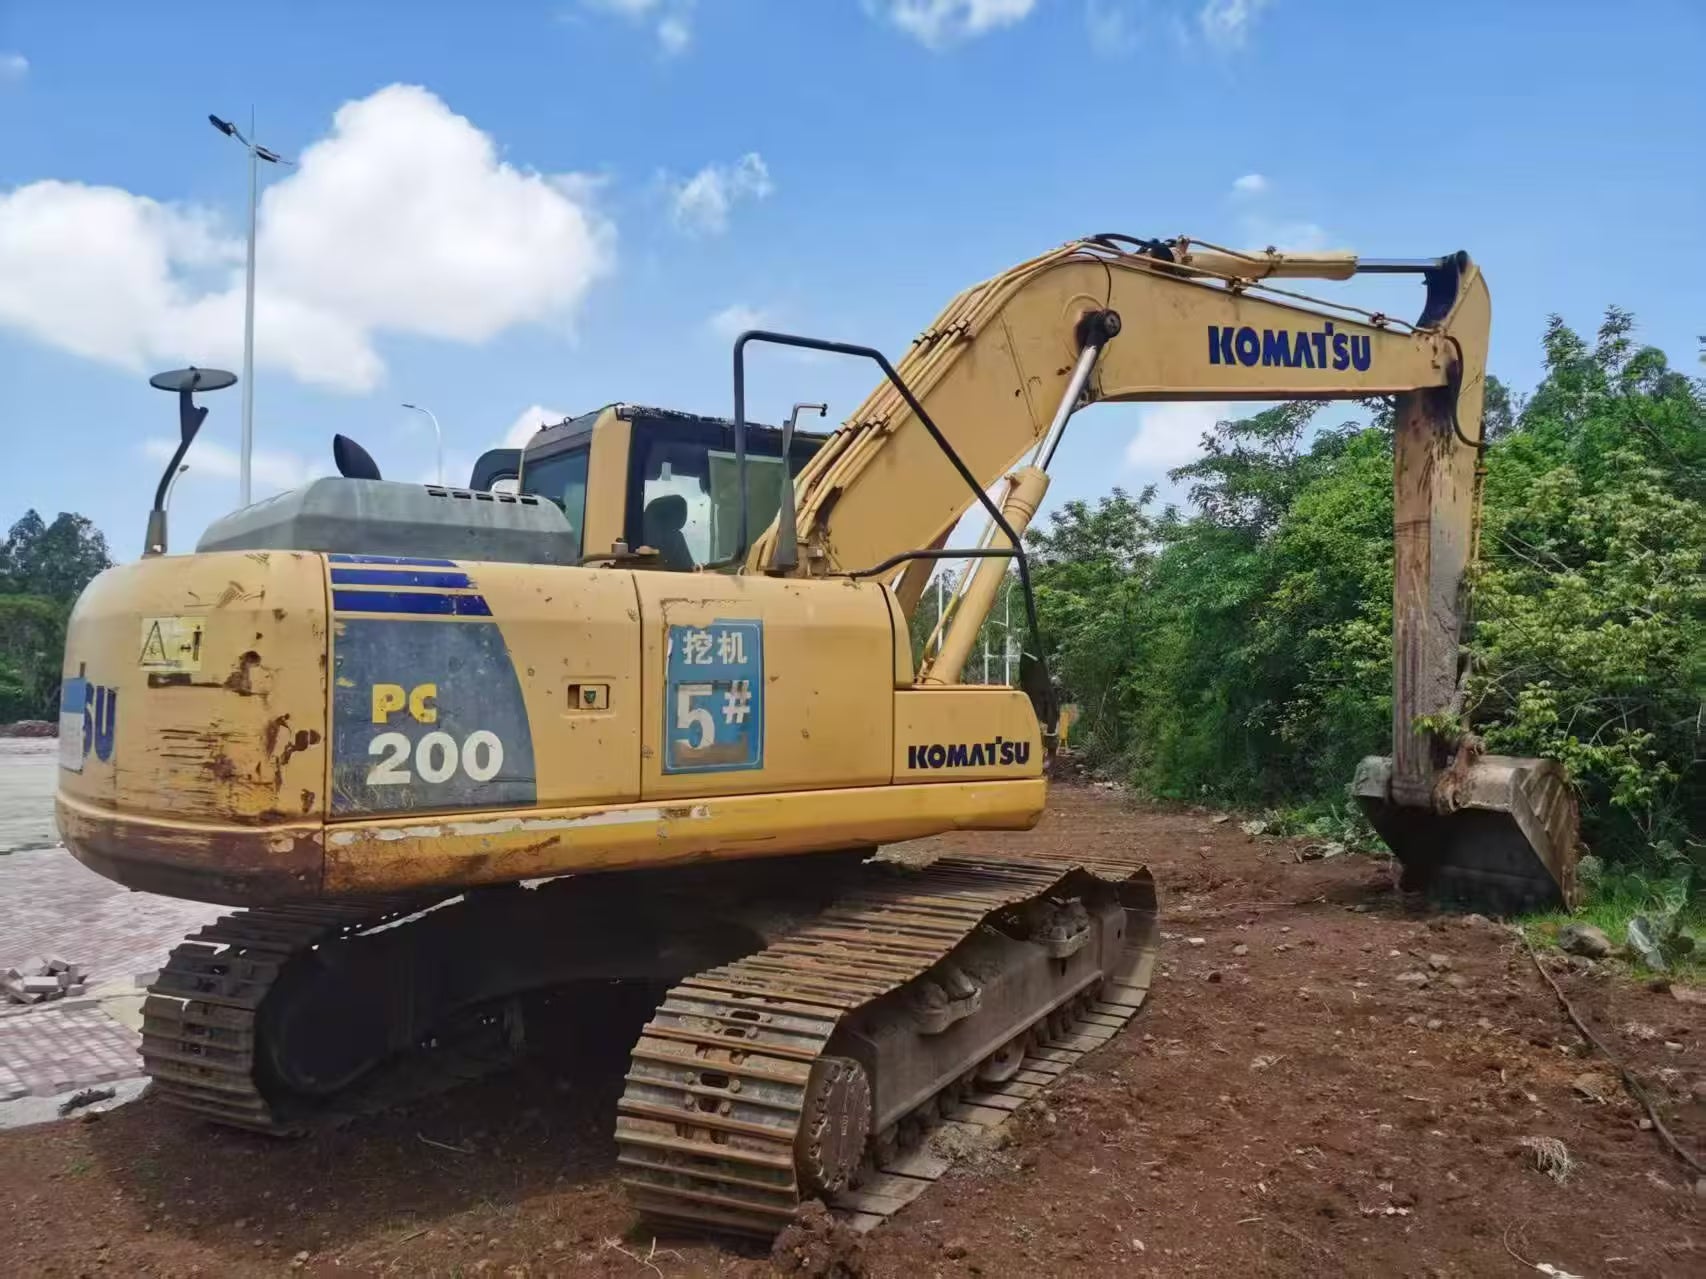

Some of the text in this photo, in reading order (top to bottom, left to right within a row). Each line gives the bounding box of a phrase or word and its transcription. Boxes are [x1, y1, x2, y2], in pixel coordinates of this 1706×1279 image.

[1208, 322, 1371, 371] KOMATSU
[682, 630, 748, 665] 挖机
[372, 683, 437, 724] PC
[676, 680, 752, 750] 5#
[366, 730, 504, 785] 200
[908, 736, 1030, 769] KOMATSU
